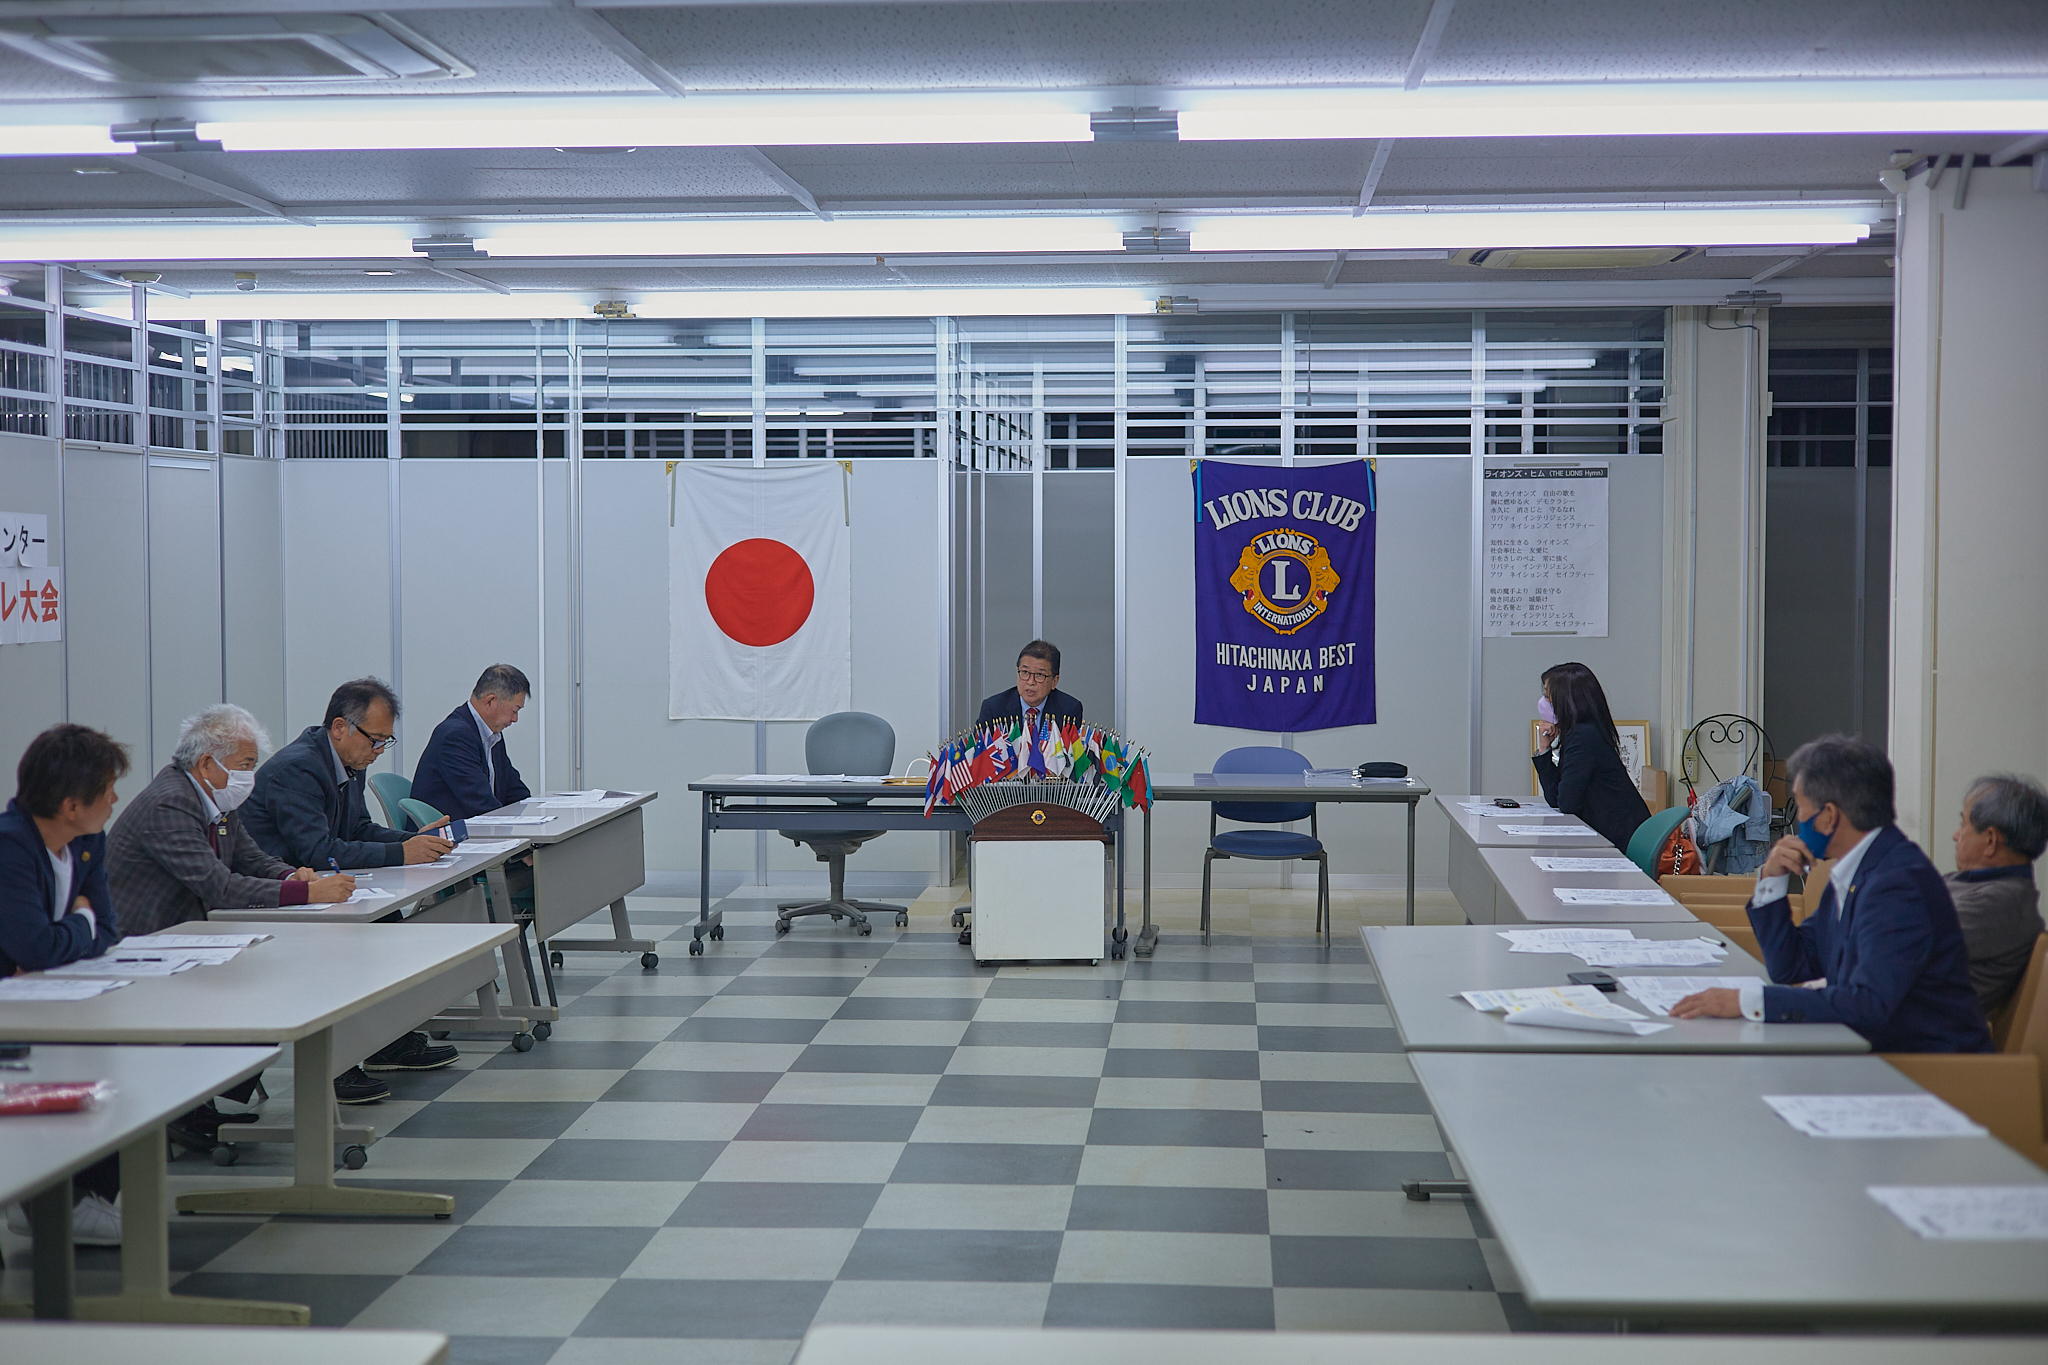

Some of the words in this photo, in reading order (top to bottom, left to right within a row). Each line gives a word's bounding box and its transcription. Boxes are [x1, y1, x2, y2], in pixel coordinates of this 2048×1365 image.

[1204, 488, 1288, 531] LIONS
[1292, 490, 1366, 532] CLUB
[3, 525, 45, 554] ンター
[1255, 533, 1313, 555] LIONS
[1271, 560, 1302, 600] L
[1, 579, 58, 623] レ大会
[1254, 601, 1318, 626] INTERNATIONAL
[1216, 643, 1313, 671] HITACHINAKA
[1319, 643, 1356, 669] BEST
[1247, 674, 1324, 694] JAPAN
